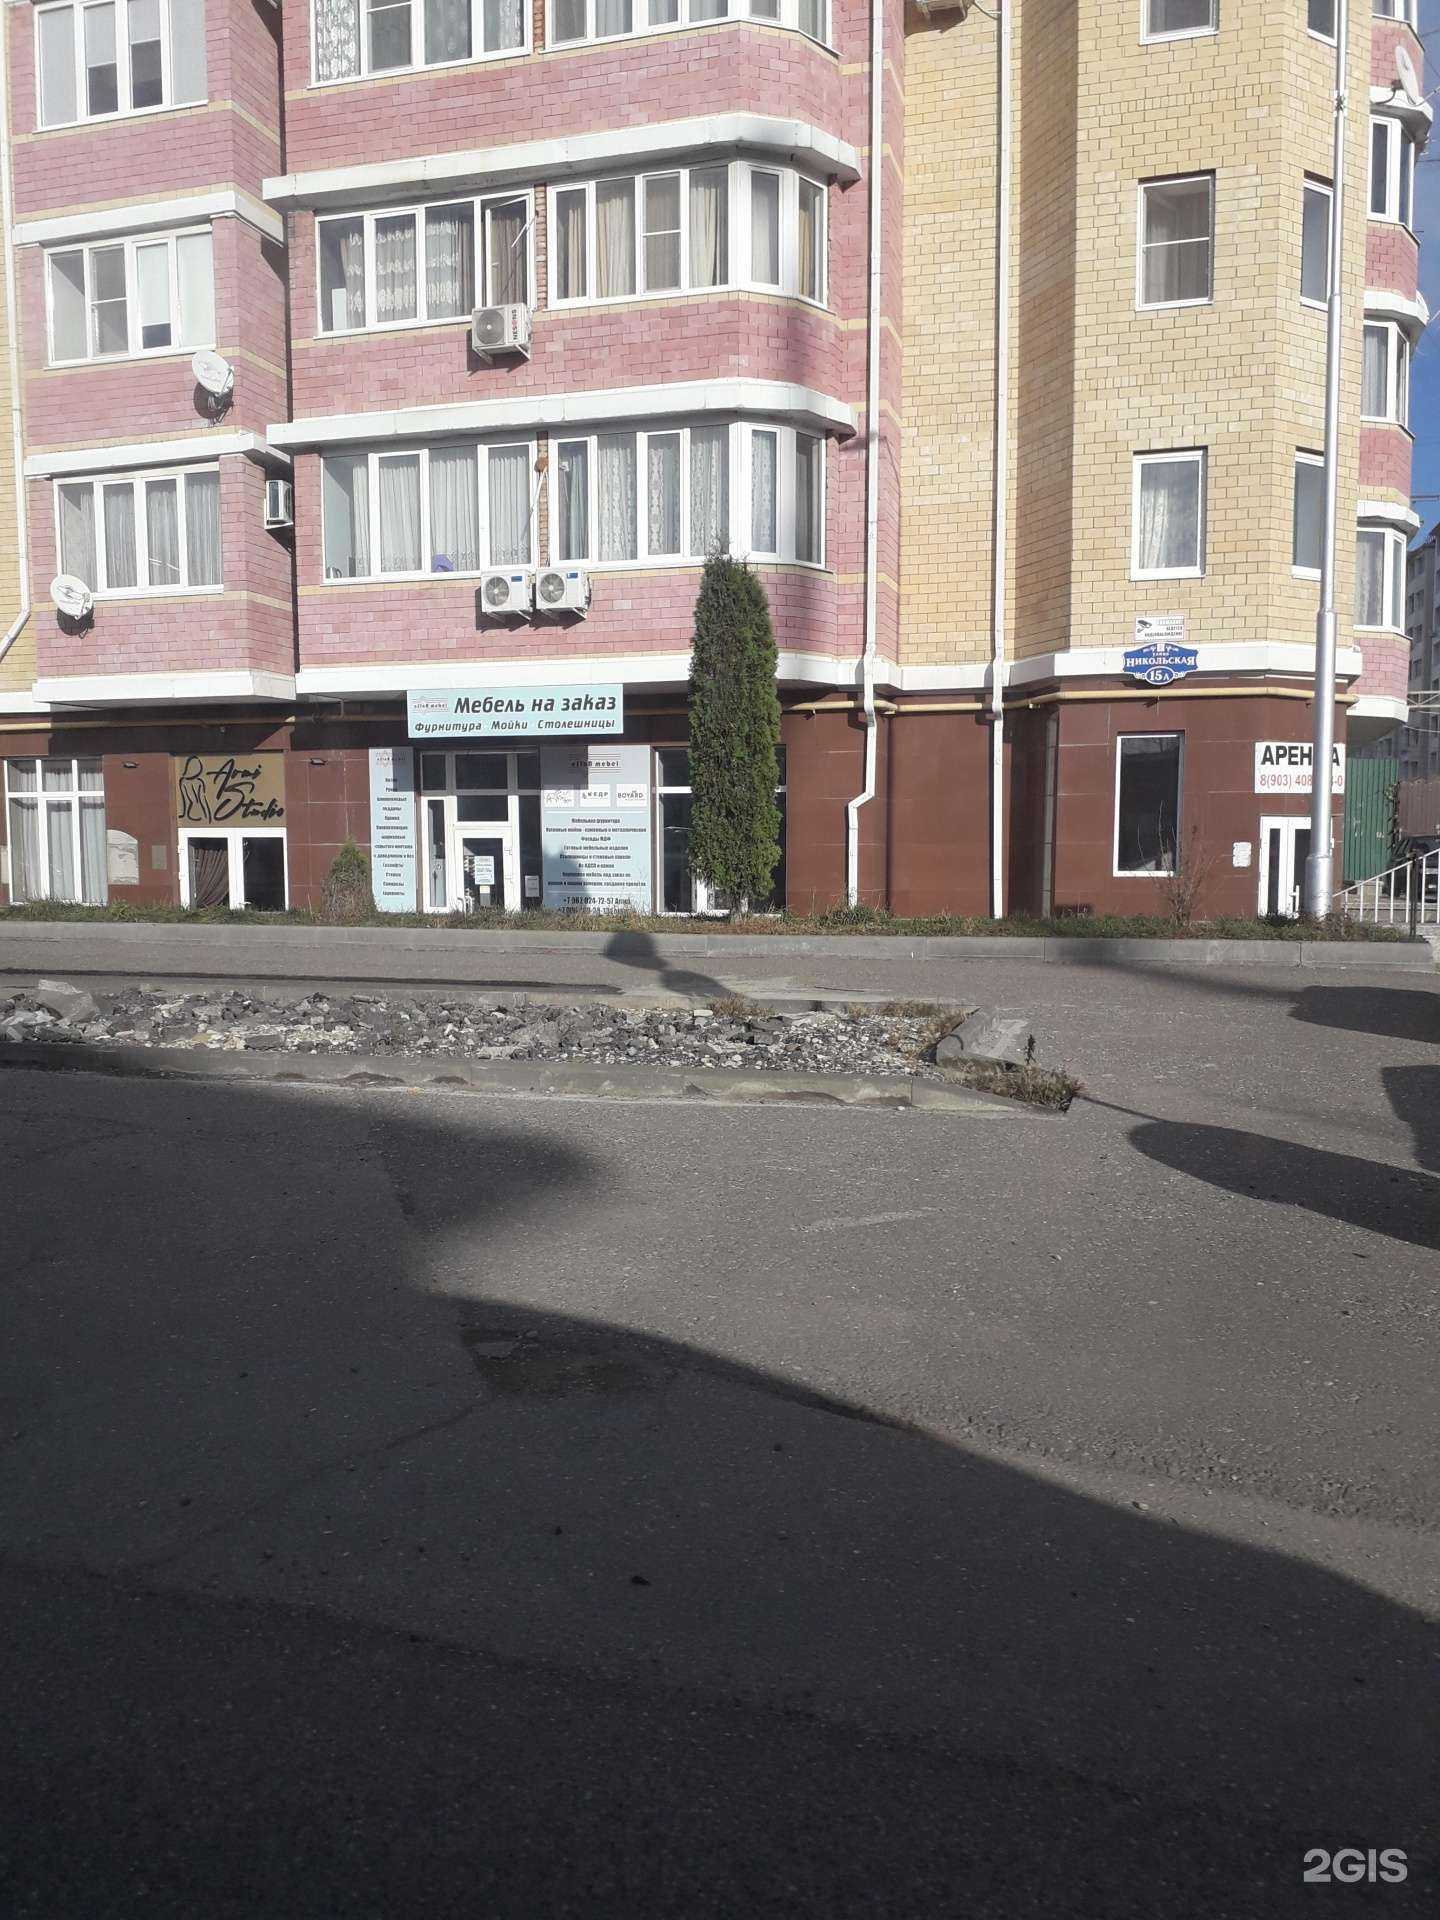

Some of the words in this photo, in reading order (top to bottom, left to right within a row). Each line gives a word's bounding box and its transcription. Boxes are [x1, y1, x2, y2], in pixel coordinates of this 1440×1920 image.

[1126, 656, 1196, 668] НИКОЛЬСКАЯ
[454, 697, 525, 714] Мебель
[531, 698, 555, 712] на
[561, 694, 617, 711] заказ
[414, 721, 483, 733] Фурнитура
[490, 720, 528, 730] Мойки
[537, 718, 616, 730] Столешницы
[1260, 745, 1340, 767] АРЕНА
[1260, 774, 1293, 790] 8(903)
[213, 781, 285, 821] Studio
